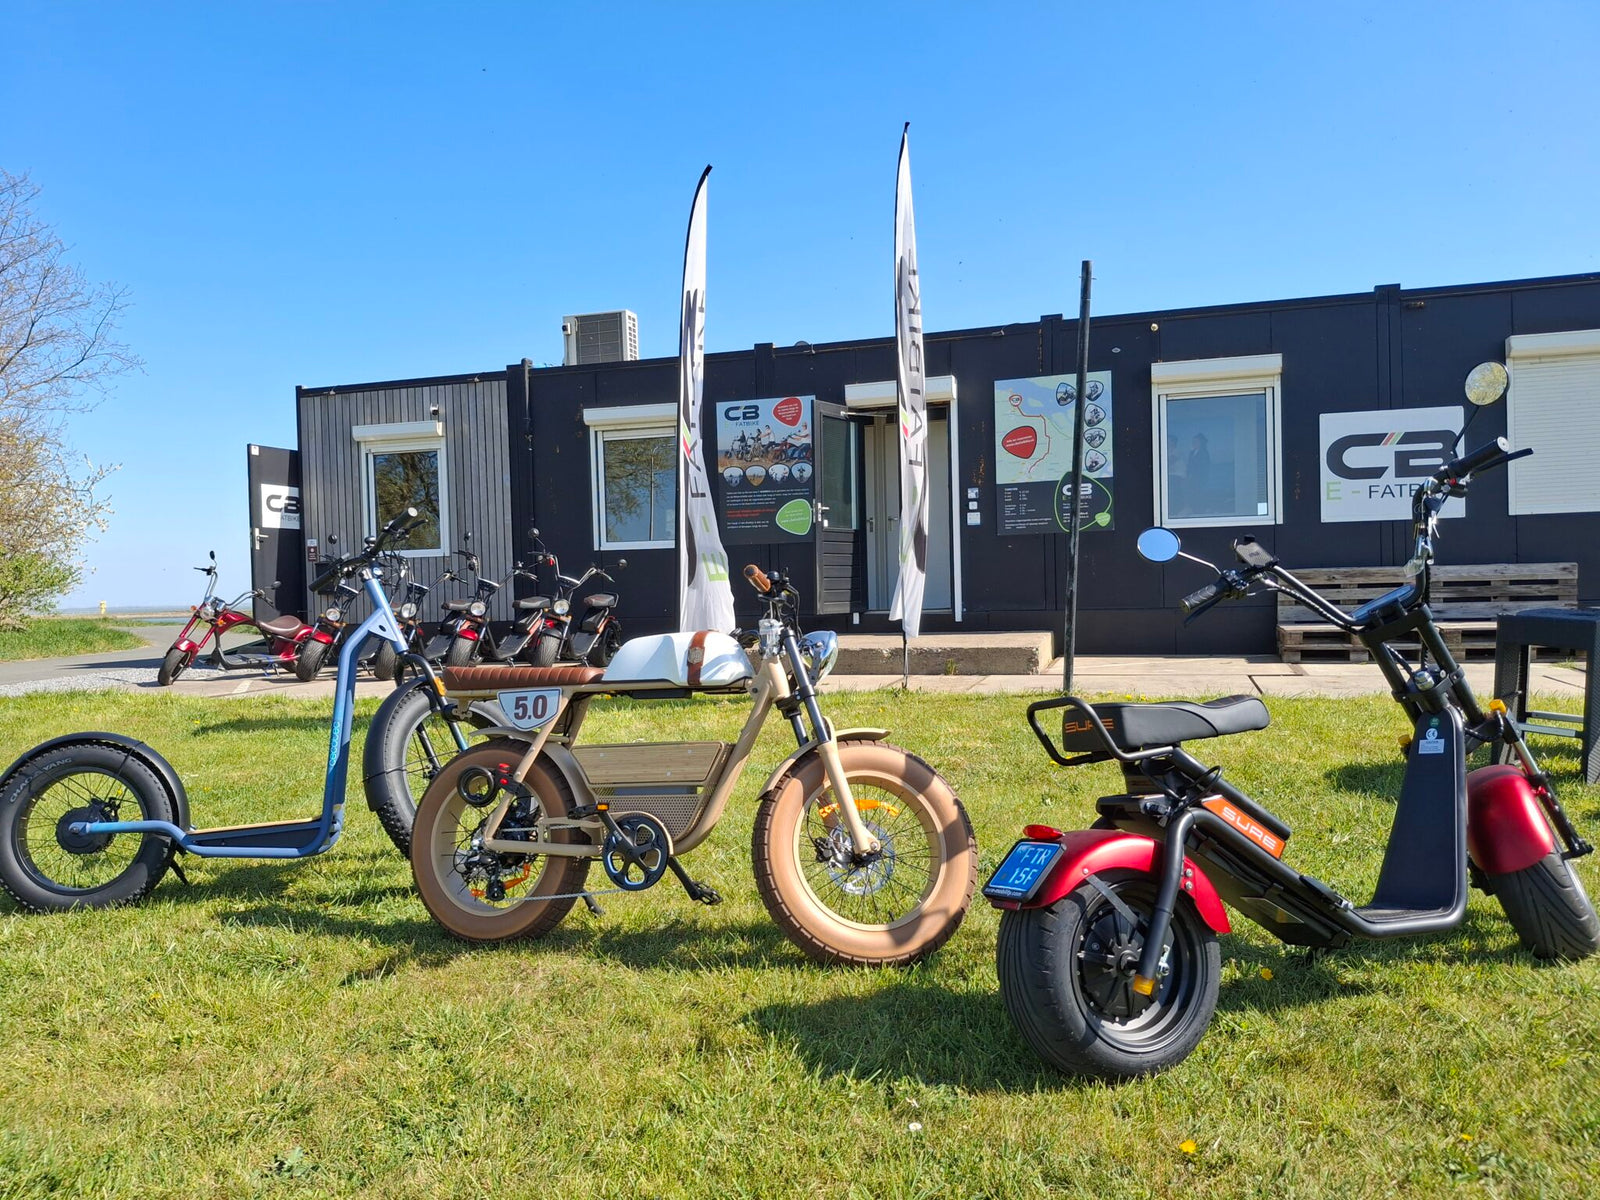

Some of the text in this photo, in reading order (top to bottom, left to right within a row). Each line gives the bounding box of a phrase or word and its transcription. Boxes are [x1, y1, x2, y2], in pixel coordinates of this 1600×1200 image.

[724, 405, 760, 421] CB
[1326, 429, 1457, 480] CB
[1326, 481, 1342, 501] E
[1368, 483, 1422, 499] FATB
[266, 494, 300, 514] CB
[514, 695, 548, 720] 5.0
[1221, 805, 1278, 851] SURE
[1020, 847, 1052, 866] FTR
